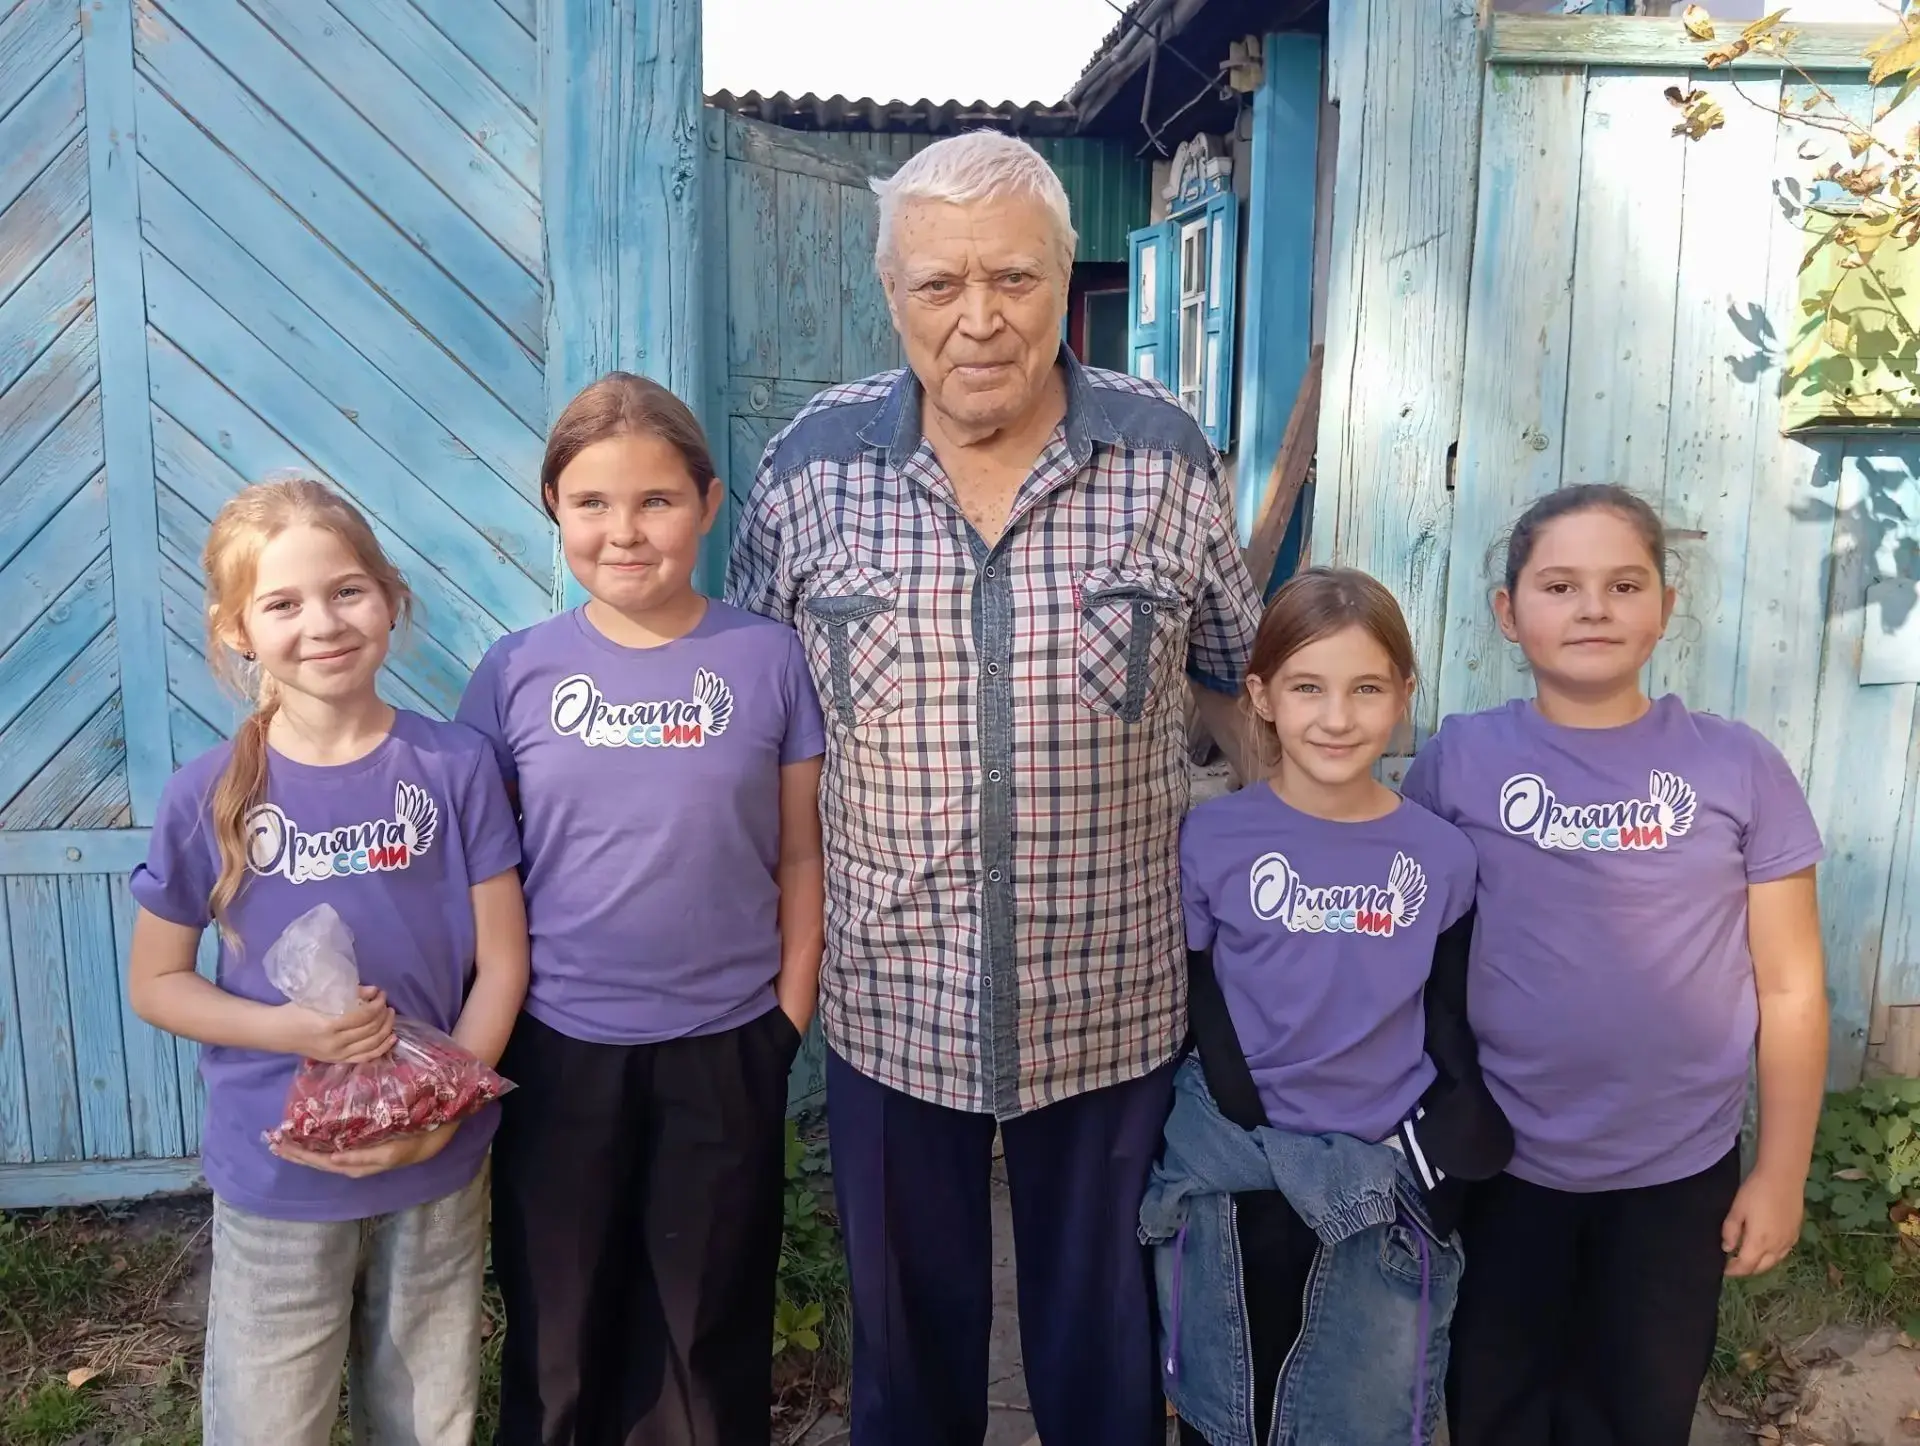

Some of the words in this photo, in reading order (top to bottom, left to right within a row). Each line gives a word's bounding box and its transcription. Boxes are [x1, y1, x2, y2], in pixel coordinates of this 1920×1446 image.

[554, 678, 702, 738] Орлята
[1503, 776, 1662, 839] Орлята
[246, 808, 406, 875] Орлята
[1253, 857, 1394, 923] Орлята
